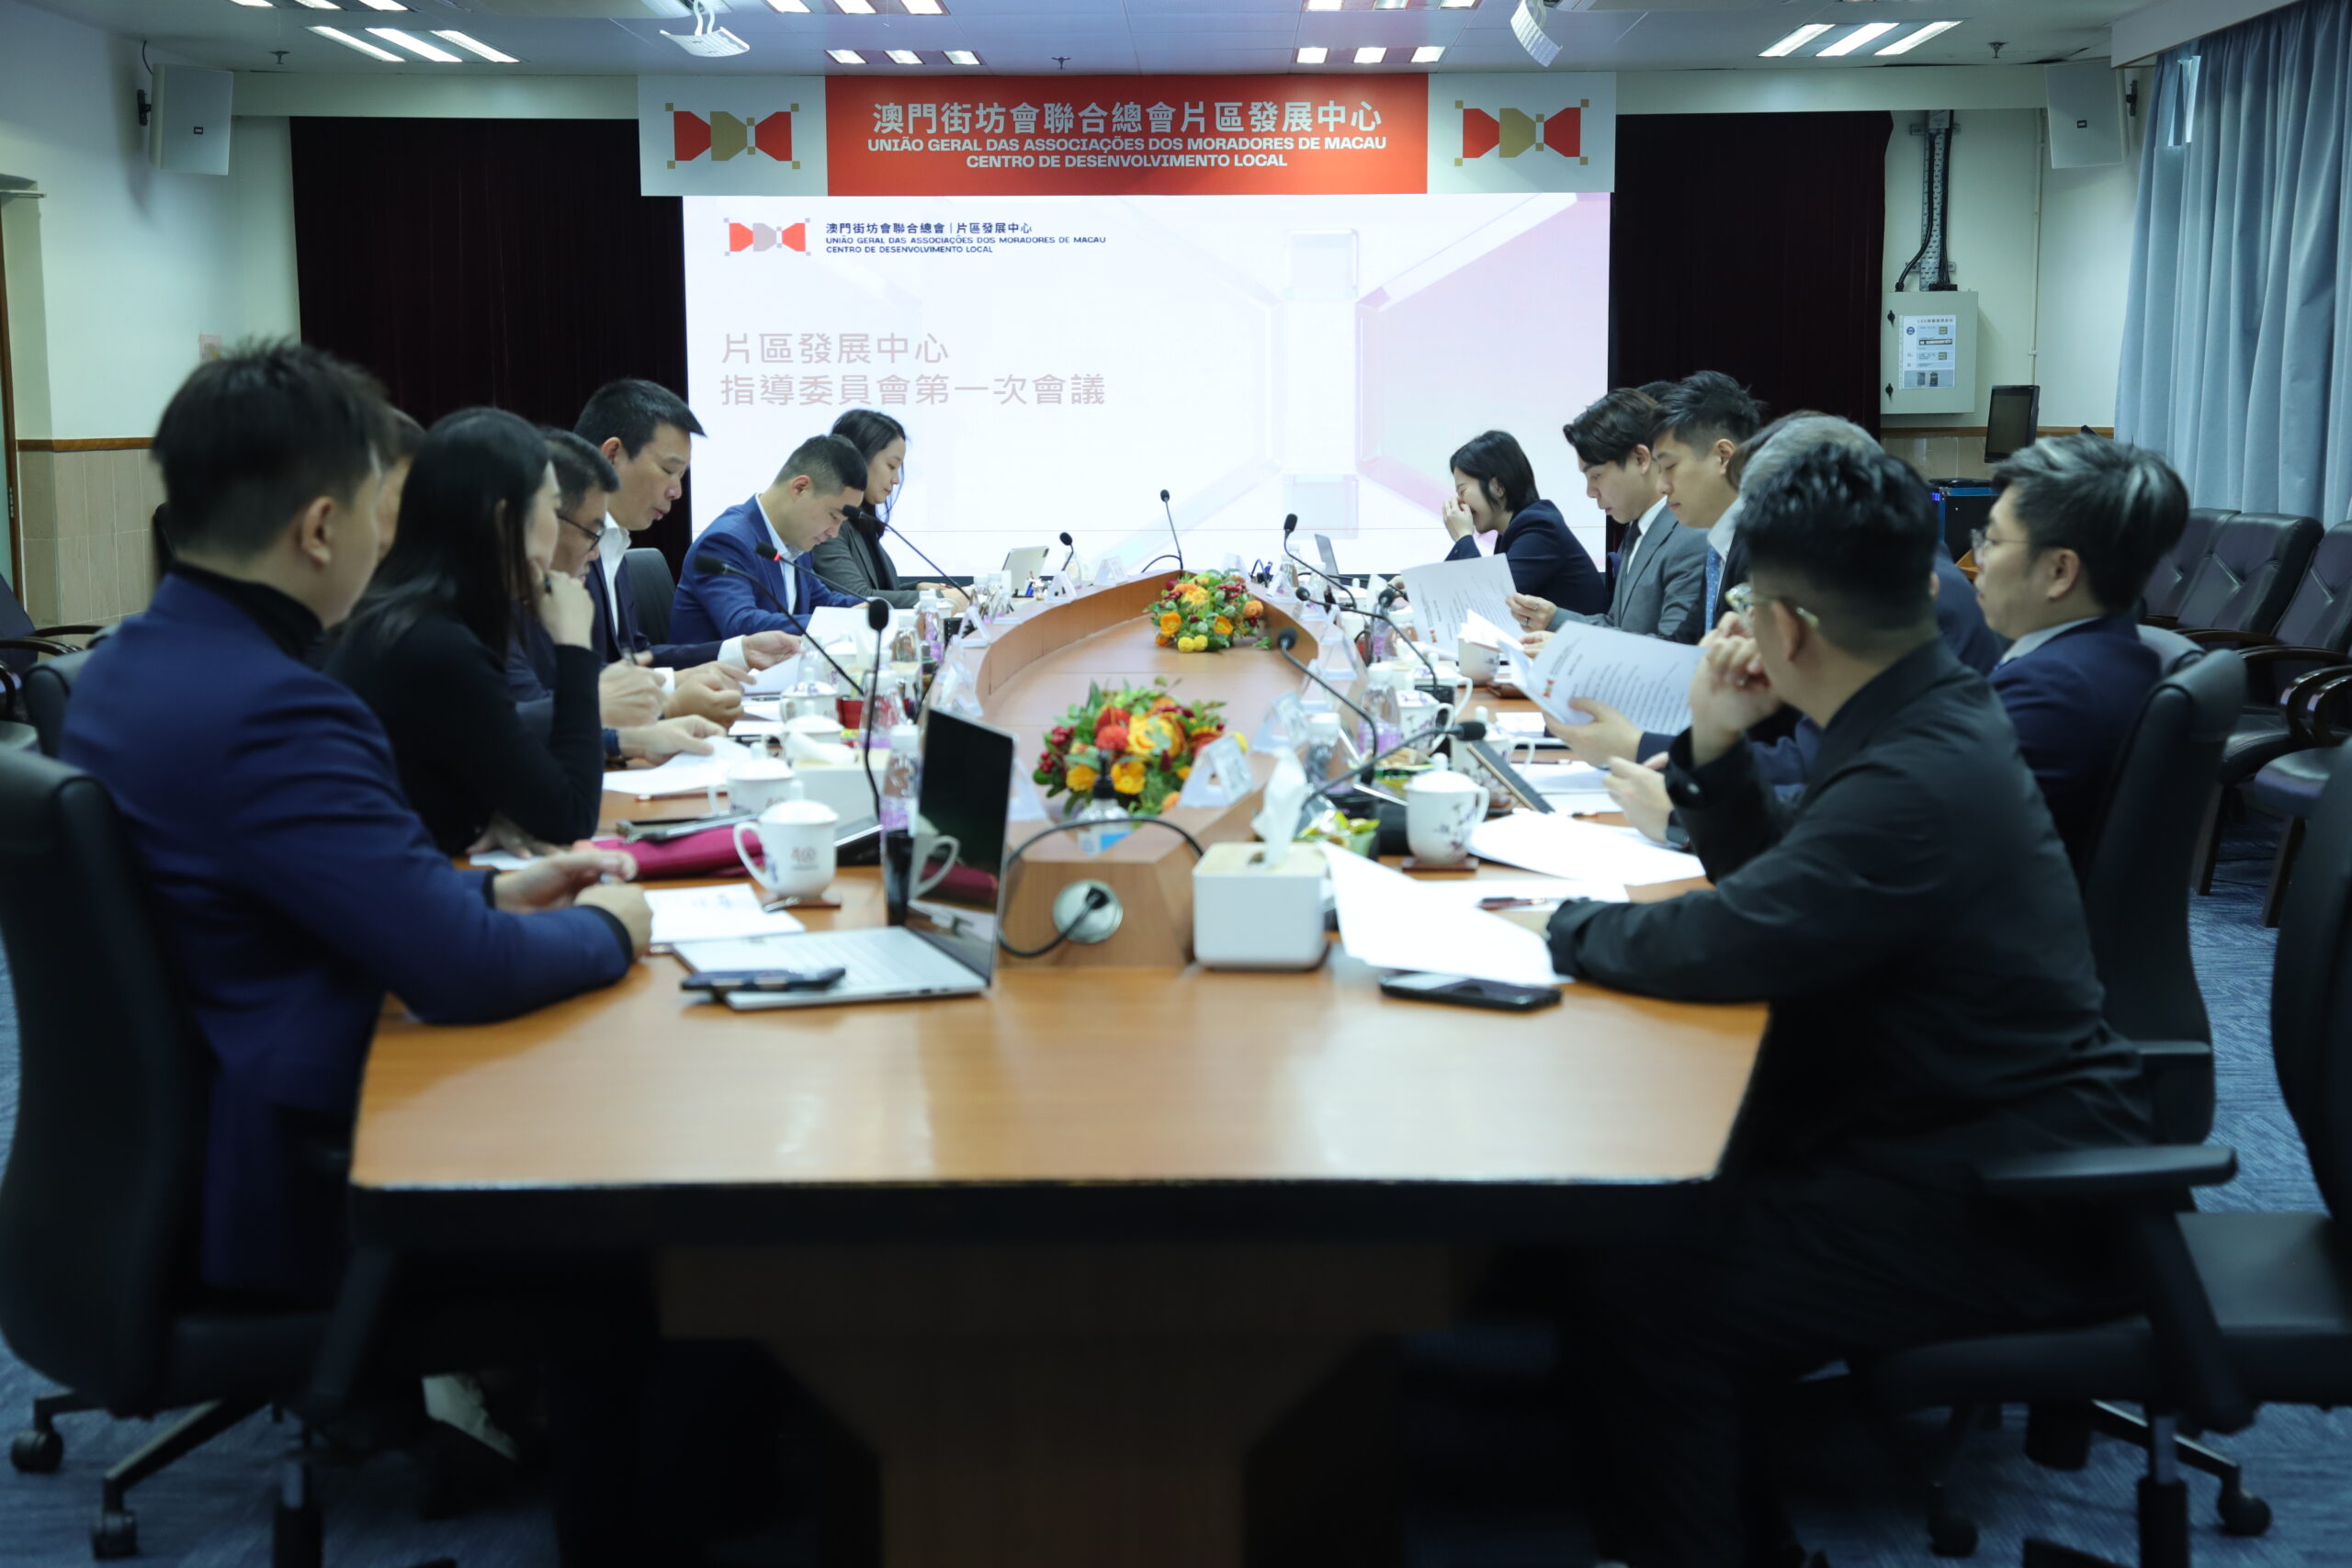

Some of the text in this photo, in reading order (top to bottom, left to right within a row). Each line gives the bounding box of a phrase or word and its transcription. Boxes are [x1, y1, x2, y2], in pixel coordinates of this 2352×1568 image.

[873, 100, 1382, 134] 澳門街坊會聯合總會片區發展中心
[867, 135, 1386, 153] UNIÃO GERAL DAS ASSOCIAÇÕES DOS MORADORES DE MACAU
[967, 153, 1287, 168] CENTRO DE DESENVOLVIMENTO LOCAL
[826, 222, 1033, 234] 澳門街坊會聯合總會 片區發展中心
[826, 234, 854, 243] UNIÃO
[910, 234, 973, 245] ASSOCIAÇÕES
[720, 333, 949, 365] 片區發展中心
[720, 373, 1106, 406] 指導委員會第一次會議
